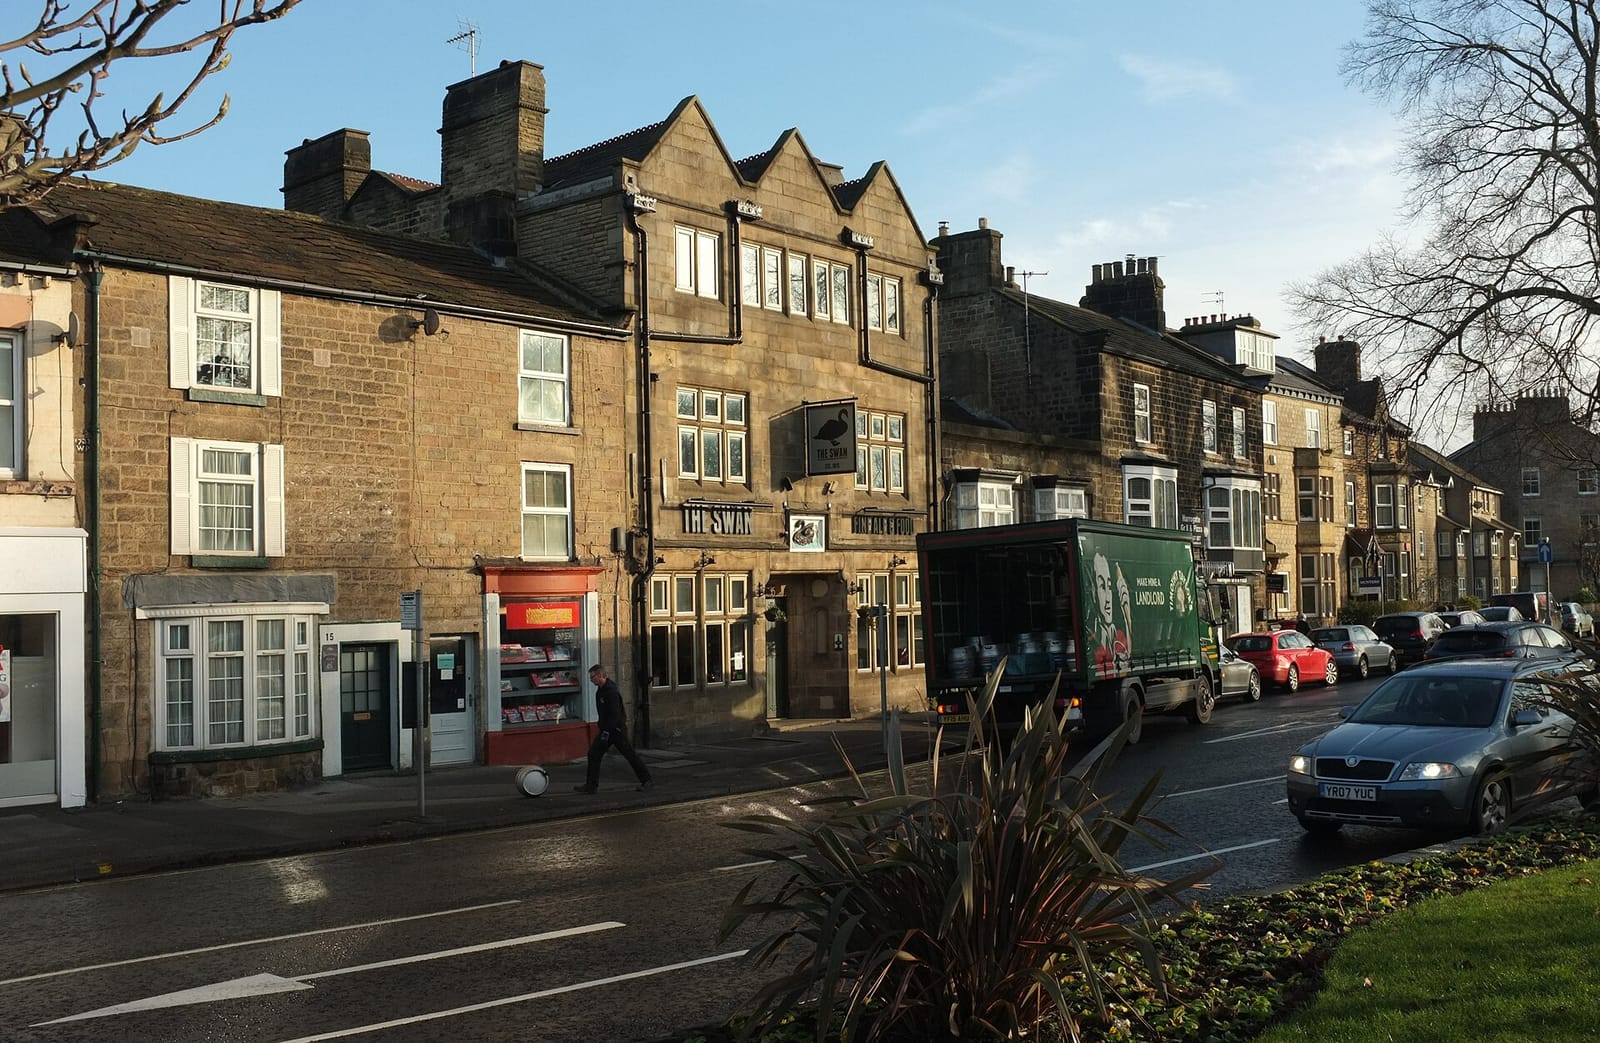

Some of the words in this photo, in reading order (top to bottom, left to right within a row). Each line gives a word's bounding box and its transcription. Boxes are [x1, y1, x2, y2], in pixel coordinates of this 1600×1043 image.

[817, 448, 828, 459] THE
[829, 447, 848, 458] SWAN
[682, 505, 706, 534] THE
[711, 506, 753, 535] SWAN
[1136, 577, 1148, 587] MAKE
[1147, 577, 1158, 587] MINE
[1135, 590, 1165, 606] LANDLORD
[325, 632, 335, 642] 15
[1326, 786, 1351, 798] YR07
[1354, 788, 1374, 799] YUC
